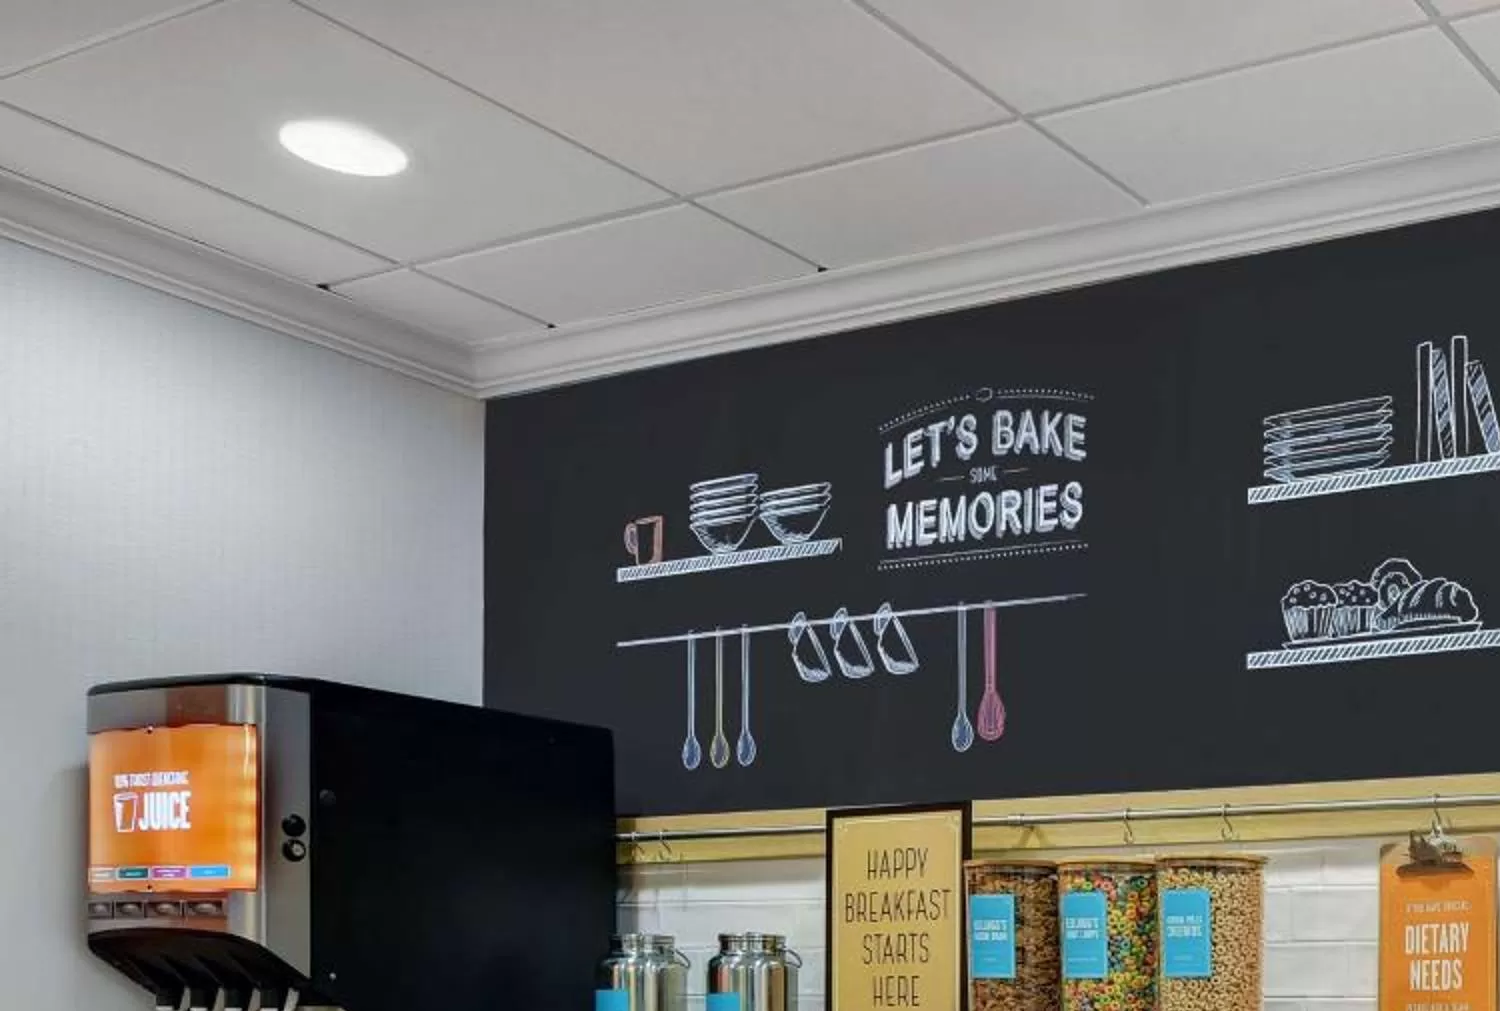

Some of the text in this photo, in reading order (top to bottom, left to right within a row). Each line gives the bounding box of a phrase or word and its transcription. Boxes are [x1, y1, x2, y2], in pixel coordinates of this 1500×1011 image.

[884, 409, 1087, 490] LET'S BAKE
[968, 465, 998, 484] SOME
[886, 481, 1084, 550] MEMORIES
[138, 790, 192, 831] JUICE
[867, 848, 928, 880] HAPPY
[845, 889, 952, 924] BREAKFAST
[862, 933, 930, 965] STARTS
[1405, 922, 1471, 955] DIETARY
[873, 976, 920, 1008] HERE
[1409, 959, 1463, 992] NEEDS
